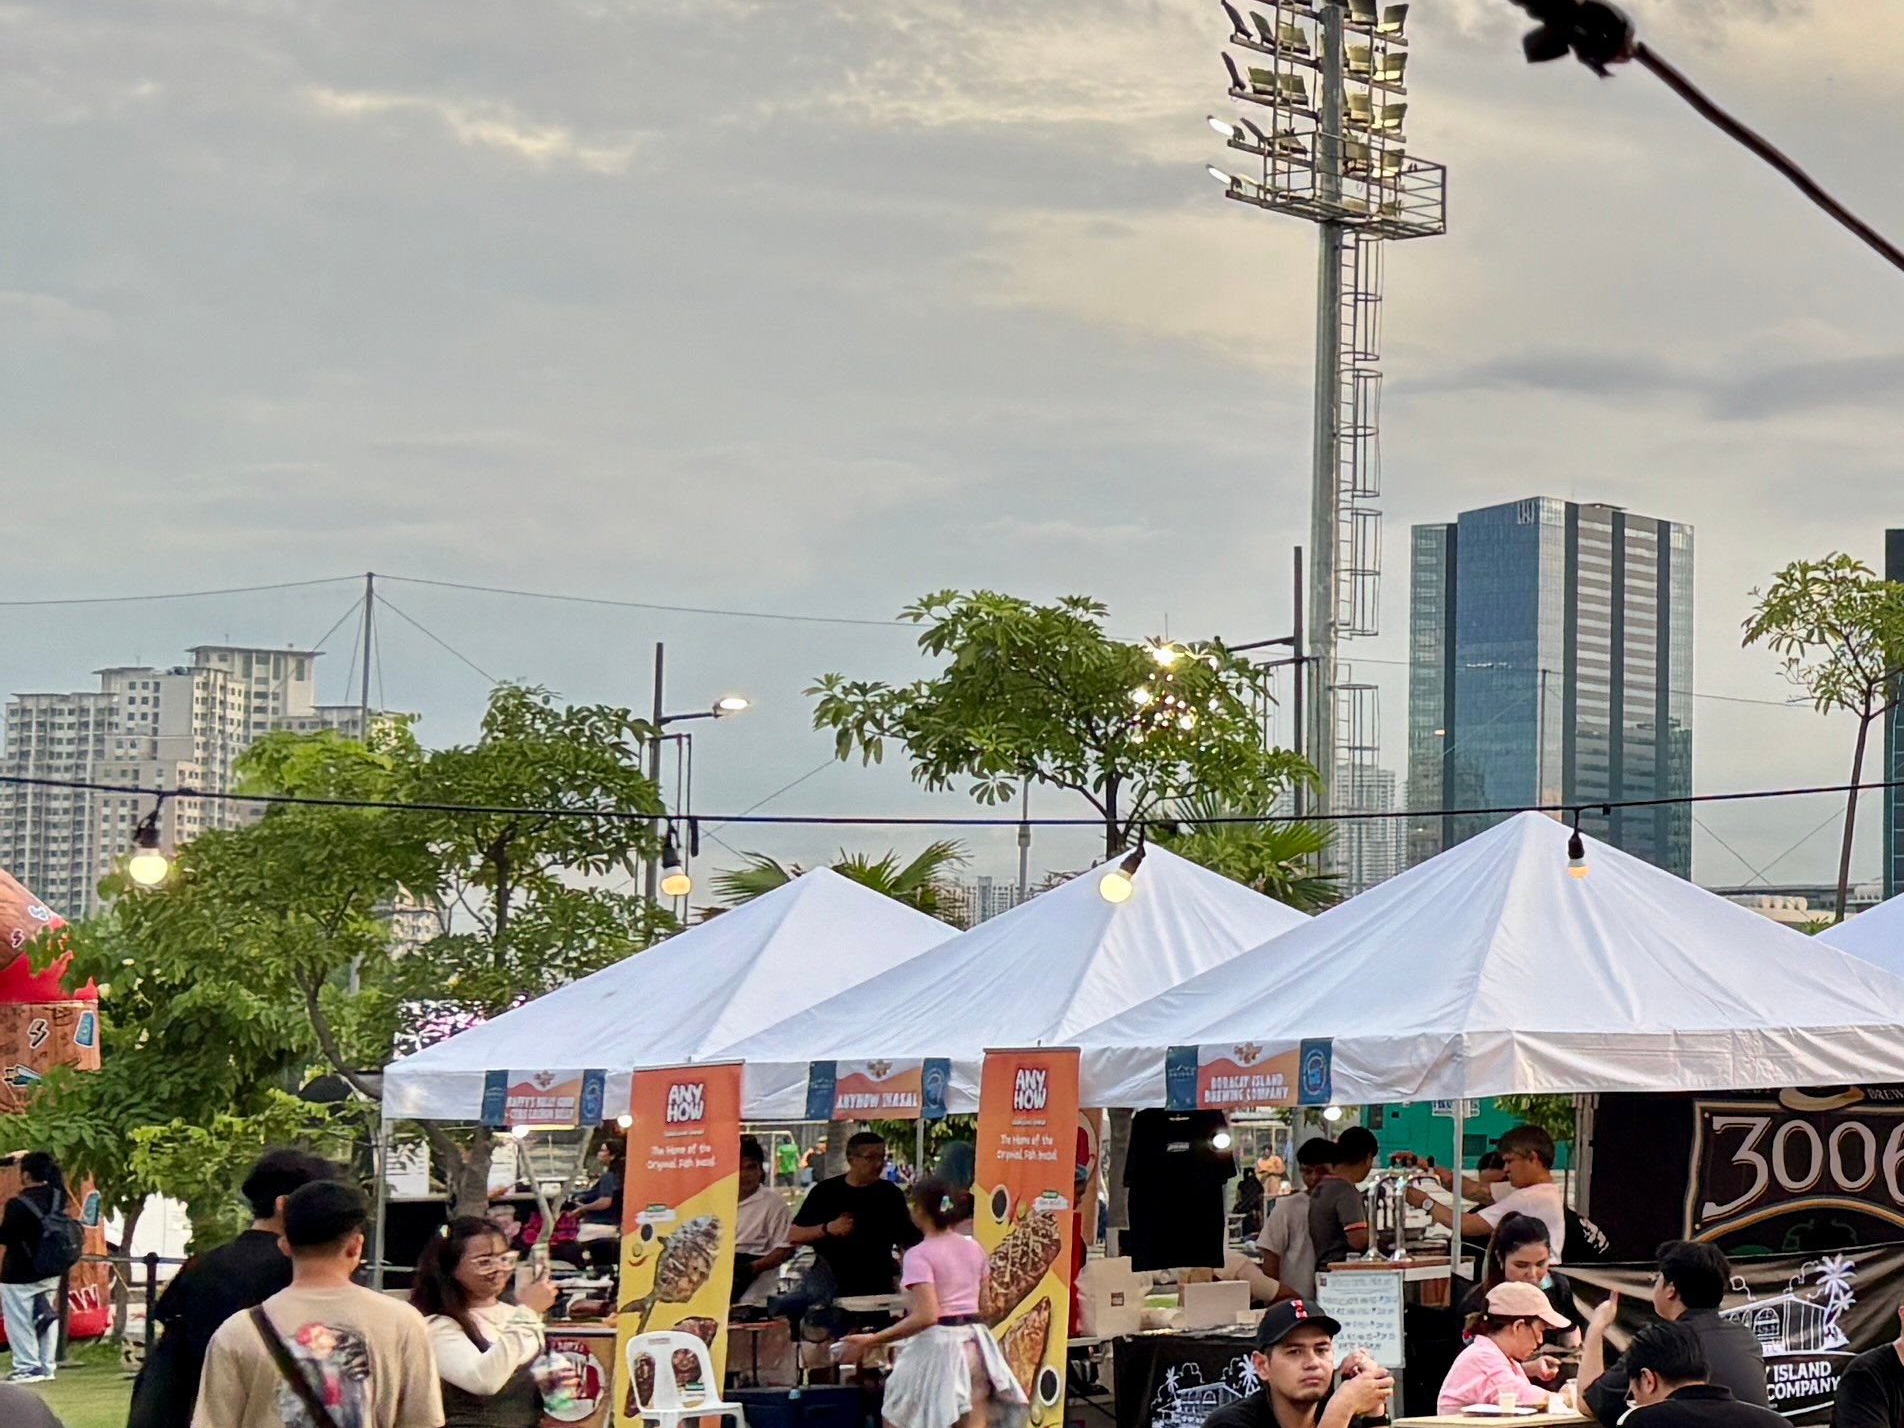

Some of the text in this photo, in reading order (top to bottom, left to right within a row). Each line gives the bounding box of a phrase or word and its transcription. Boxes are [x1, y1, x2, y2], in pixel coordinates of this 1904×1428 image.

[1016, 1068, 1046, 1091] ANY
[668, 1083, 704, 1104] ANY
[1013, 1087, 1047, 1110] HOW
[666, 1100, 705, 1123] HOW
[1773, 1361, 1832, 1383] ISLAND
[1766, 1376, 1841, 1401] COMPANY
